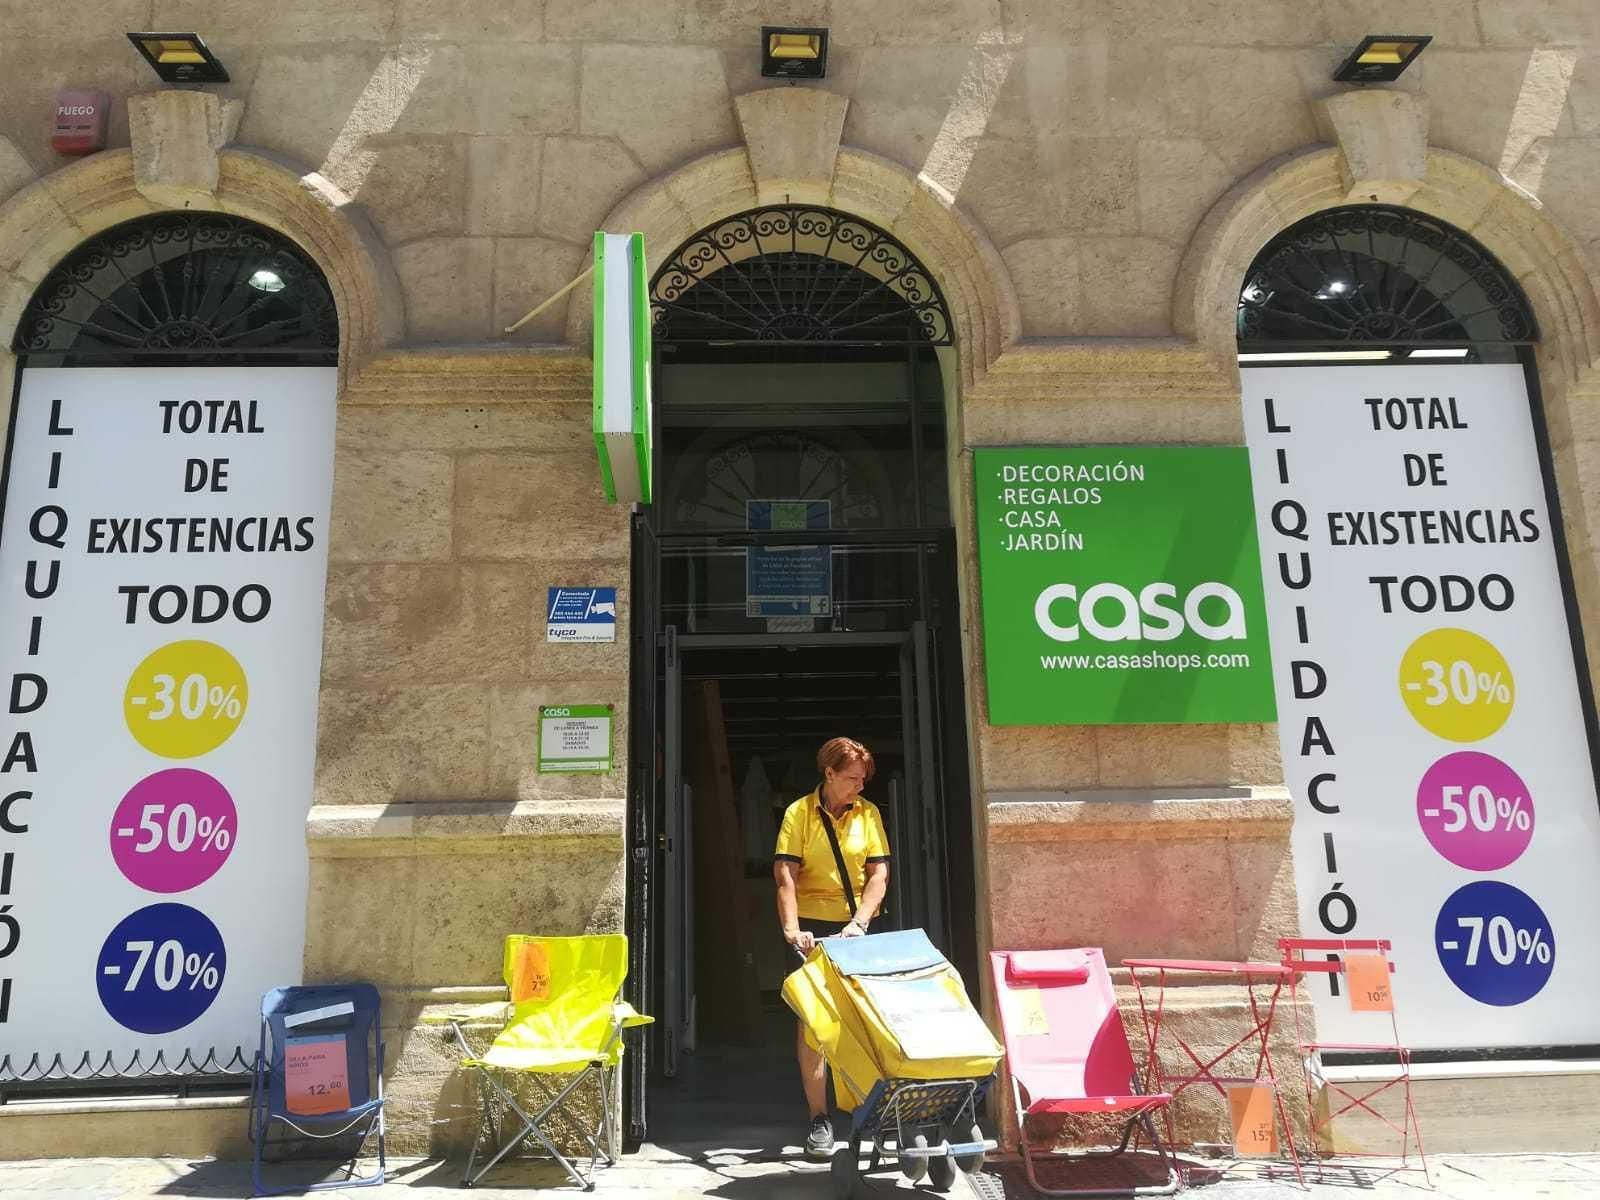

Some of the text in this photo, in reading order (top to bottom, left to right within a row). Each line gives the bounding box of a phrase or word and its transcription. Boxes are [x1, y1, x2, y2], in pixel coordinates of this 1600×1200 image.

[59, 106, 95, 116] FUEGO
[159, 400, 265, 434] TOTAL
[1365, 398, 1468, 431] TOTAL
[184, 458, 230, 493] DE
[1403, 453, 1448, 487] DE
[87, 516, 315, 554] EXISTENCIAS
[1328, 509, 1540, 546] EXISTENCIAS
[118, 583, 272, 625] TODO
[1035, 582, 1248, 642] casa
[1369, 573, 1515, 614] TODO
[549, 628, 577, 638] tyco
[1041, 651, 1250, 673] www.casashops.com
[130, 675, 241, 720] -30%
[1406, 661, 1511, 705] -30%
[543, 708, 570, 717] casa
[118, 803, 230, 853] -50%
[1424, 785, 1530, 833] -50%
[1443, 916, 1551, 966] -70%
[104, 940, 218, 991] -70%
